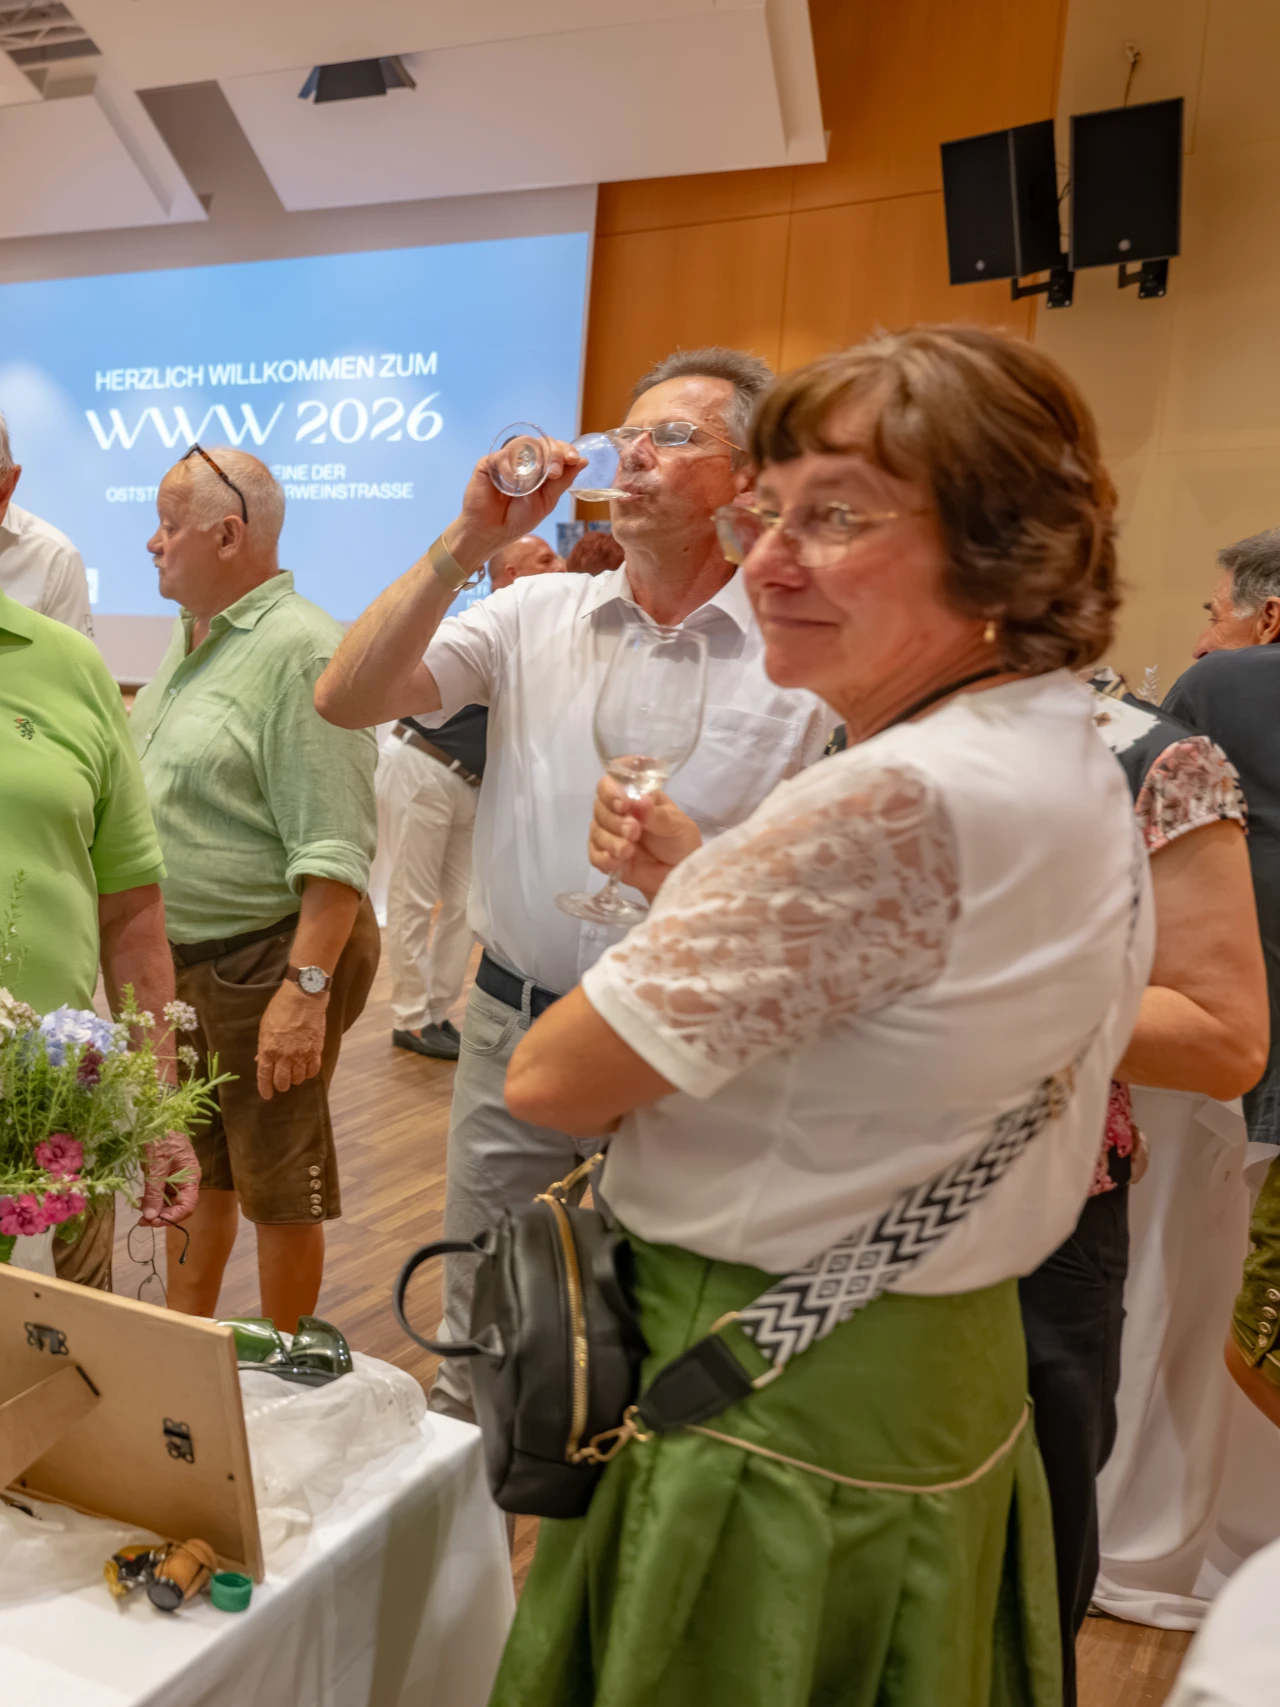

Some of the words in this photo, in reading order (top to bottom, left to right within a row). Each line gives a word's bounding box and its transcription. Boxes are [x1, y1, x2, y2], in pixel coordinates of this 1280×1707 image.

[95, 365, 205, 391] HERZLICH
[208, 358, 374, 386] WILLKOMMEN
[378, 351, 437, 378] ZUM
[85, 401, 285, 450] WWW
[295, 391, 444, 444] 2026
[270, 464, 308, 480] EINE
[311, 463, 346, 480] DER
[283, 482, 412, 500] RWEINSTRASSE
